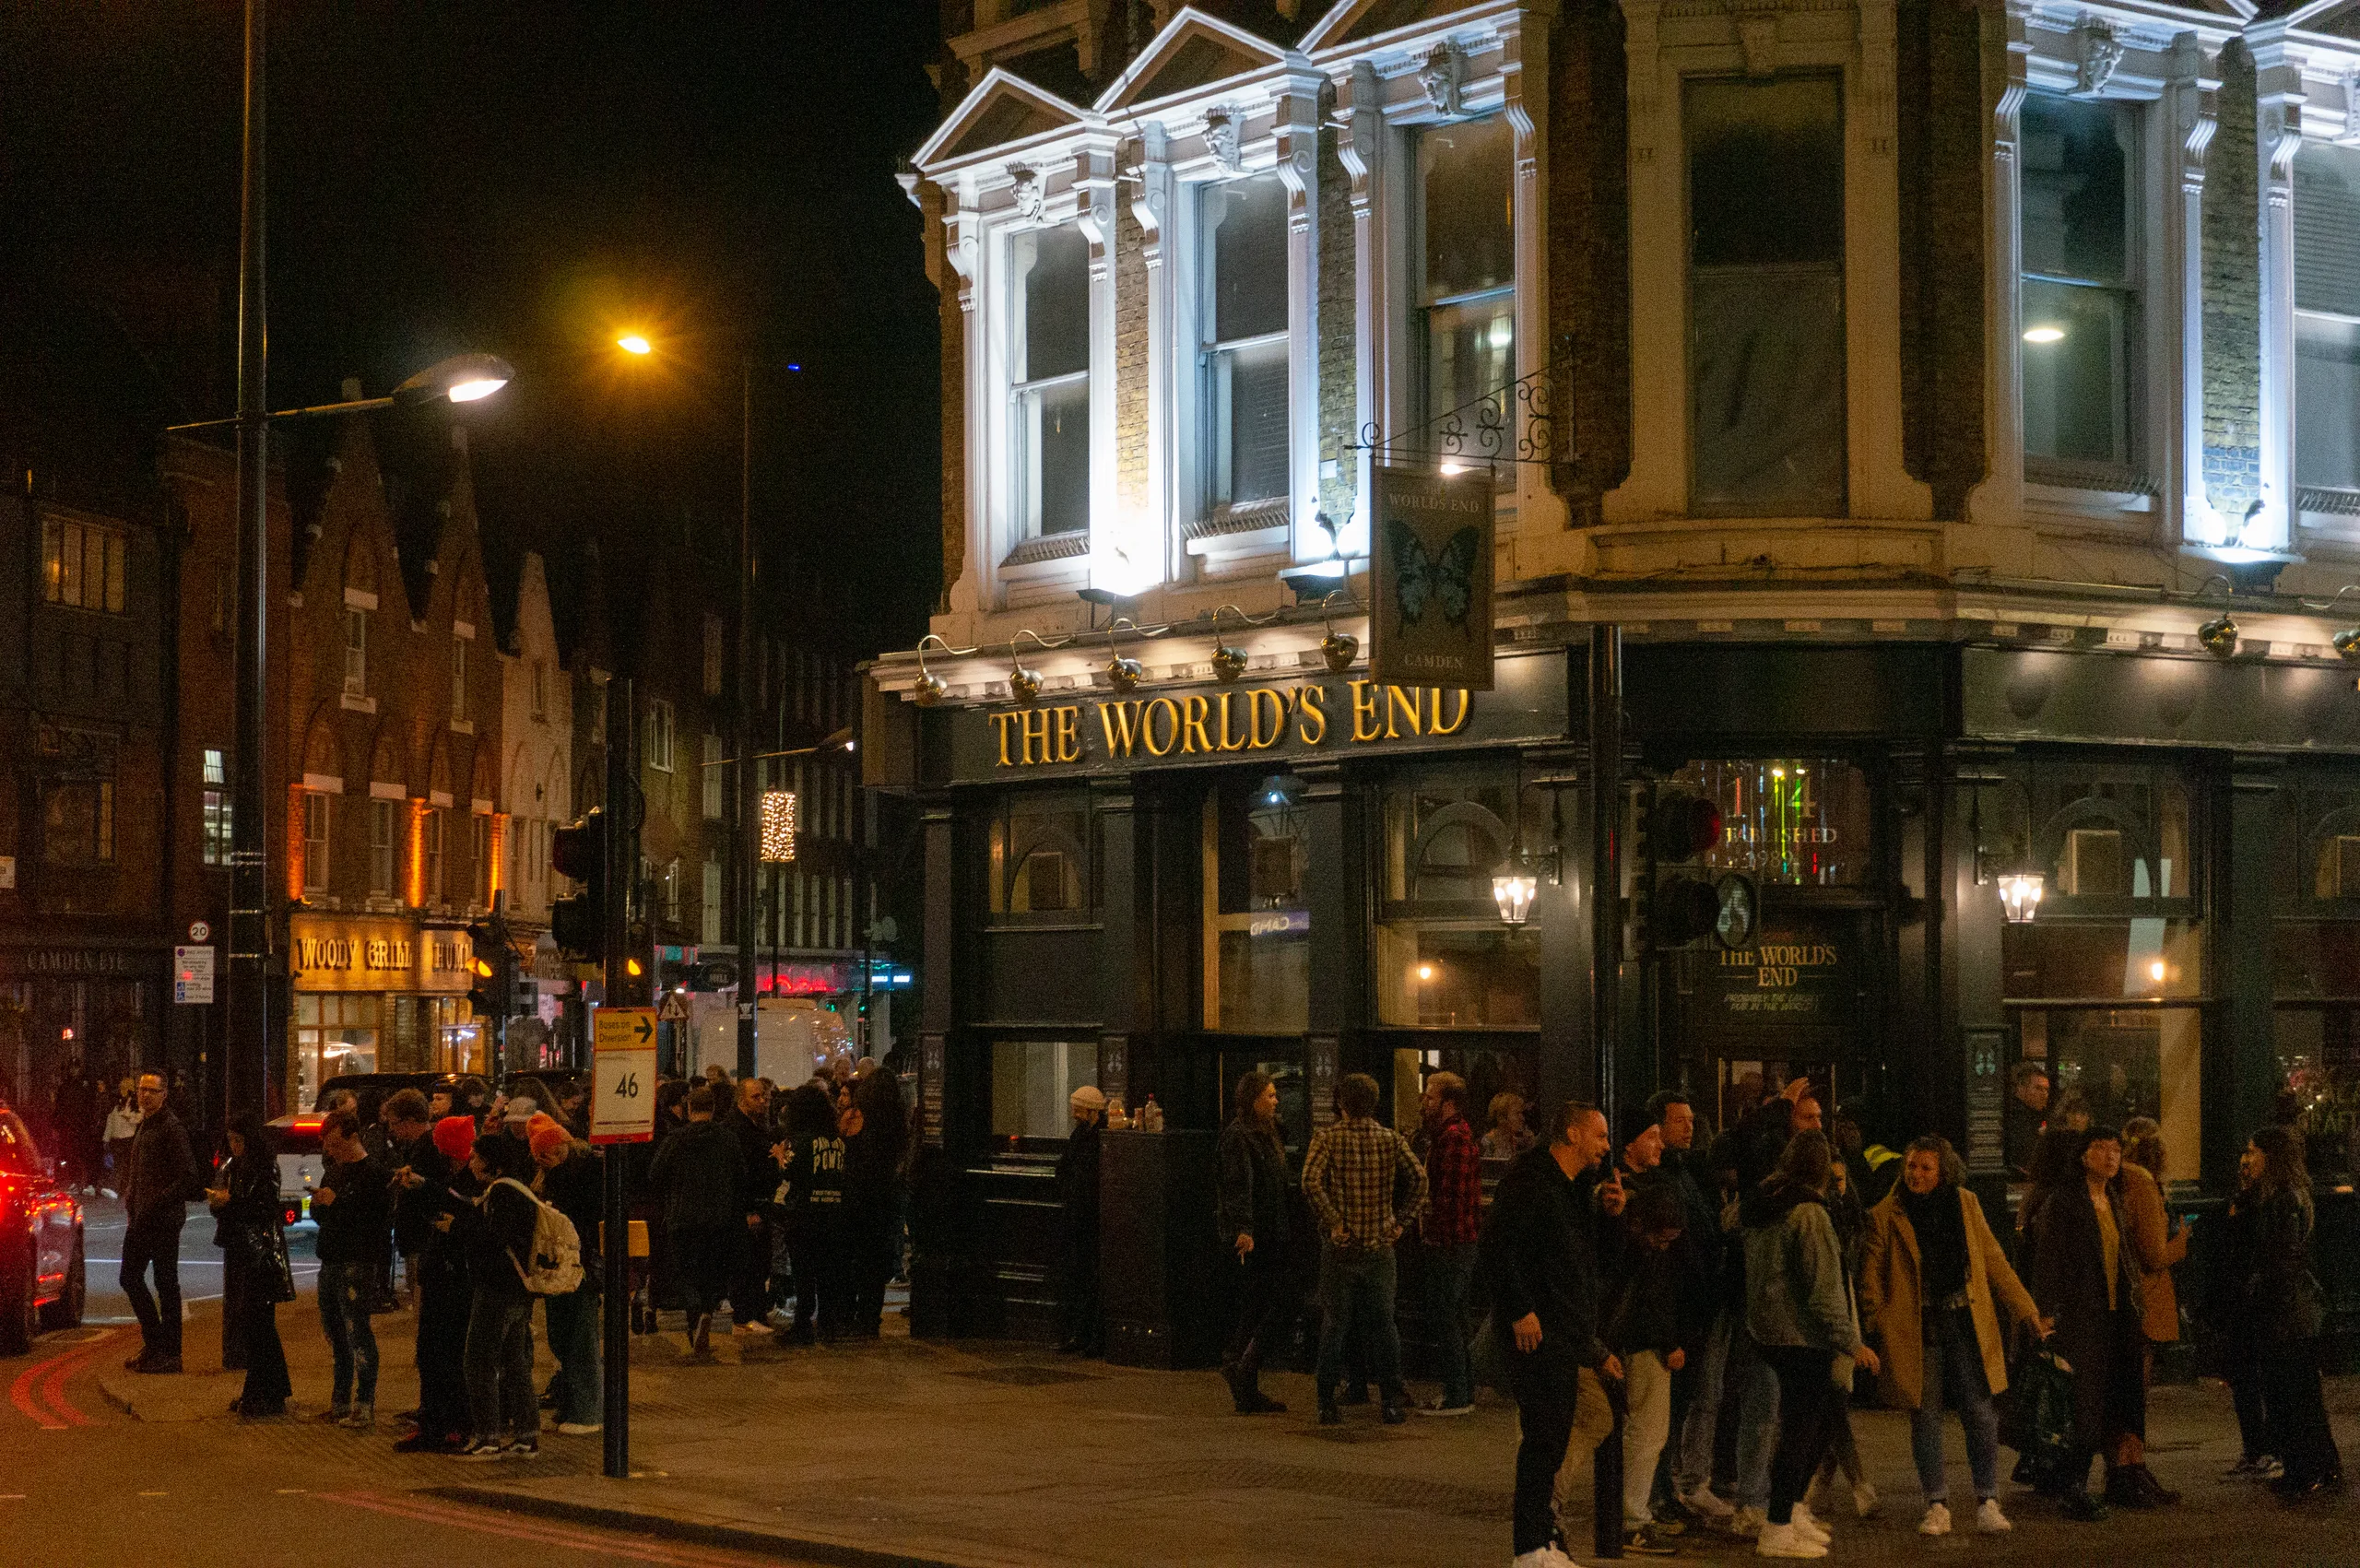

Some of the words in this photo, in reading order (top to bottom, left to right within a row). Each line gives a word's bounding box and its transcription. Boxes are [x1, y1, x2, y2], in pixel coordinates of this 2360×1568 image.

[1451, 499, 1480, 513] END
[1404, 653, 1464, 669] CAMDEN
[988, 706, 1083, 768] THE
[1097, 685, 1327, 759] WORLD'S
[1348, 679, 1473, 742] END
[192, 926, 207, 937] 20
[27, 949, 93, 971] CAMDEN
[298, 938, 359, 969] WOODY
[365, 940, 413, 970] GRILL
[1720, 950, 1754, 966] THE
[1759, 944, 1837, 966] WORLD'S
[1757, 967, 1799, 987] END
[599, 1020, 620, 1030] Buses
[620, 1020, 631, 1029] on
[599, 1032, 631, 1043] Diversion
[615, 1072, 638, 1098] 46
